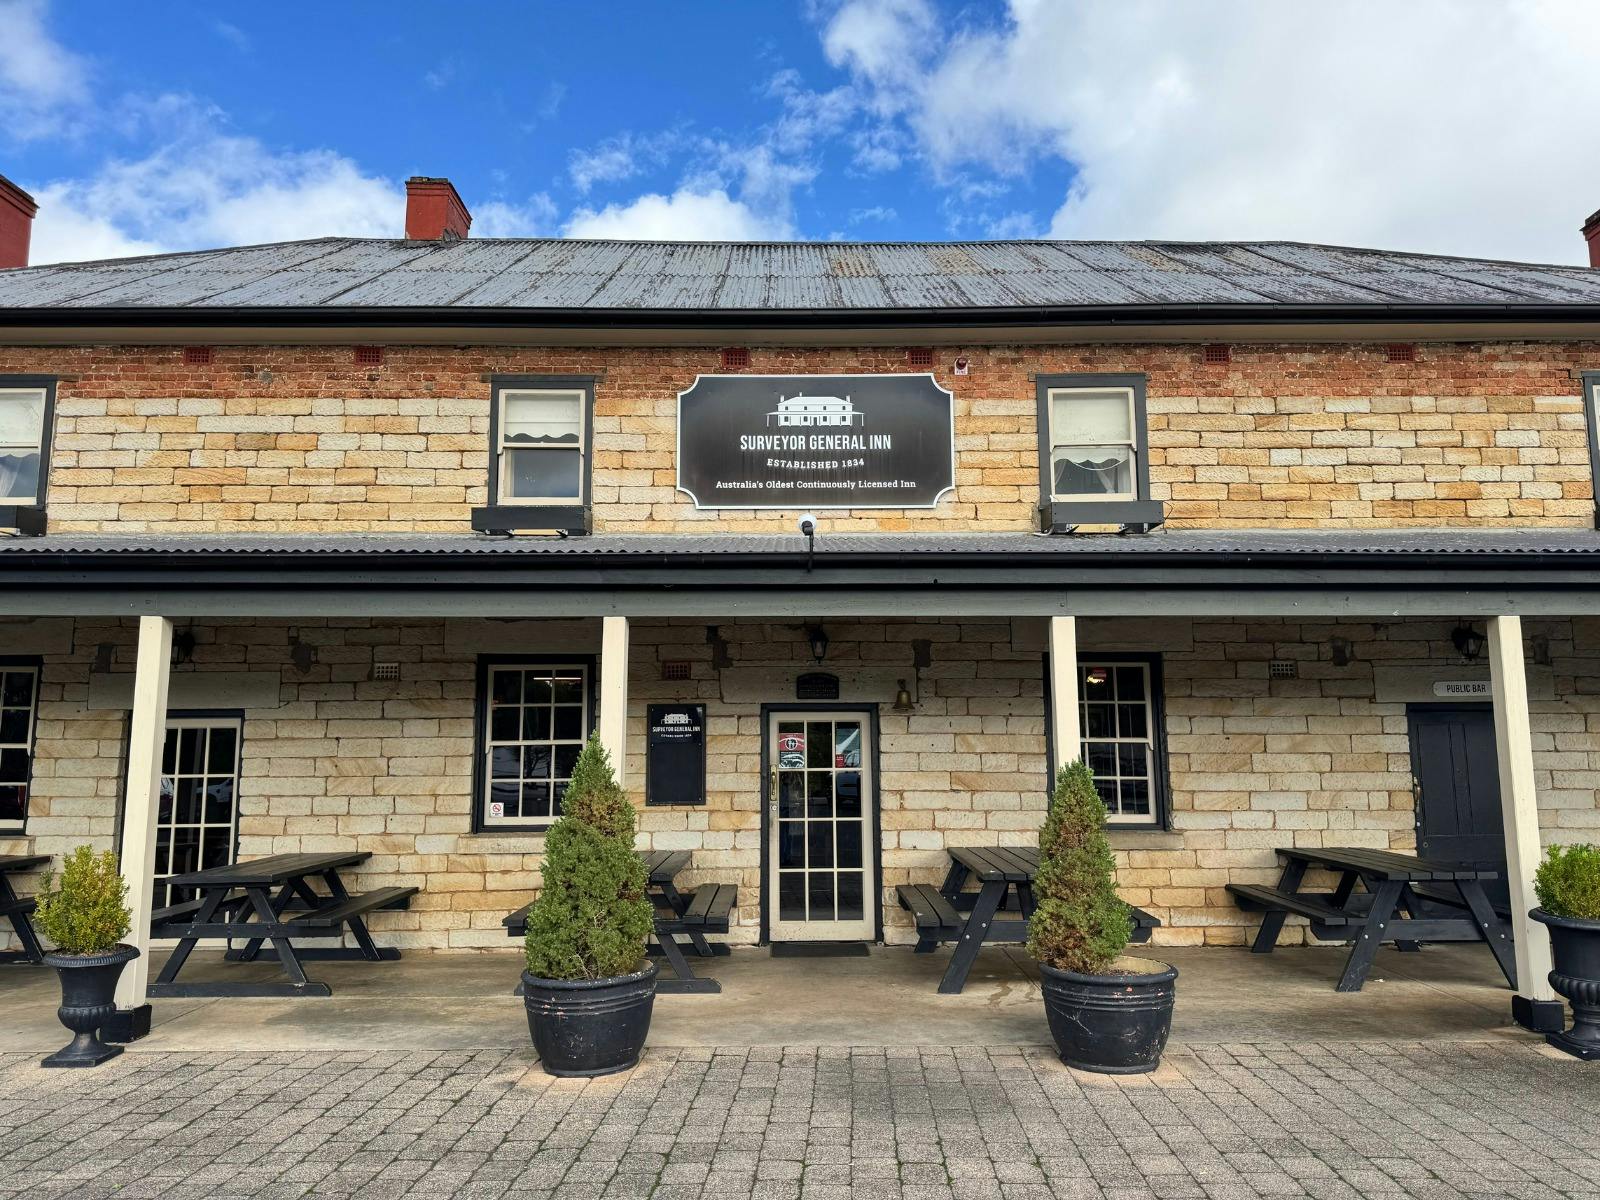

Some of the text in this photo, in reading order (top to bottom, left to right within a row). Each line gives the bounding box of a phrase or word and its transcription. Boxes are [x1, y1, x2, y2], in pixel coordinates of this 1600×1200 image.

[740, 434, 892, 450] SURVEYOR GENERAL INN
[766, 457, 865, 470] ESTABLISHED 1834
[715, 479, 917, 490] Australia's Oldest Continuously Licensed Inn
[1446, 684, 1486, 693] PUBLIC BAR
